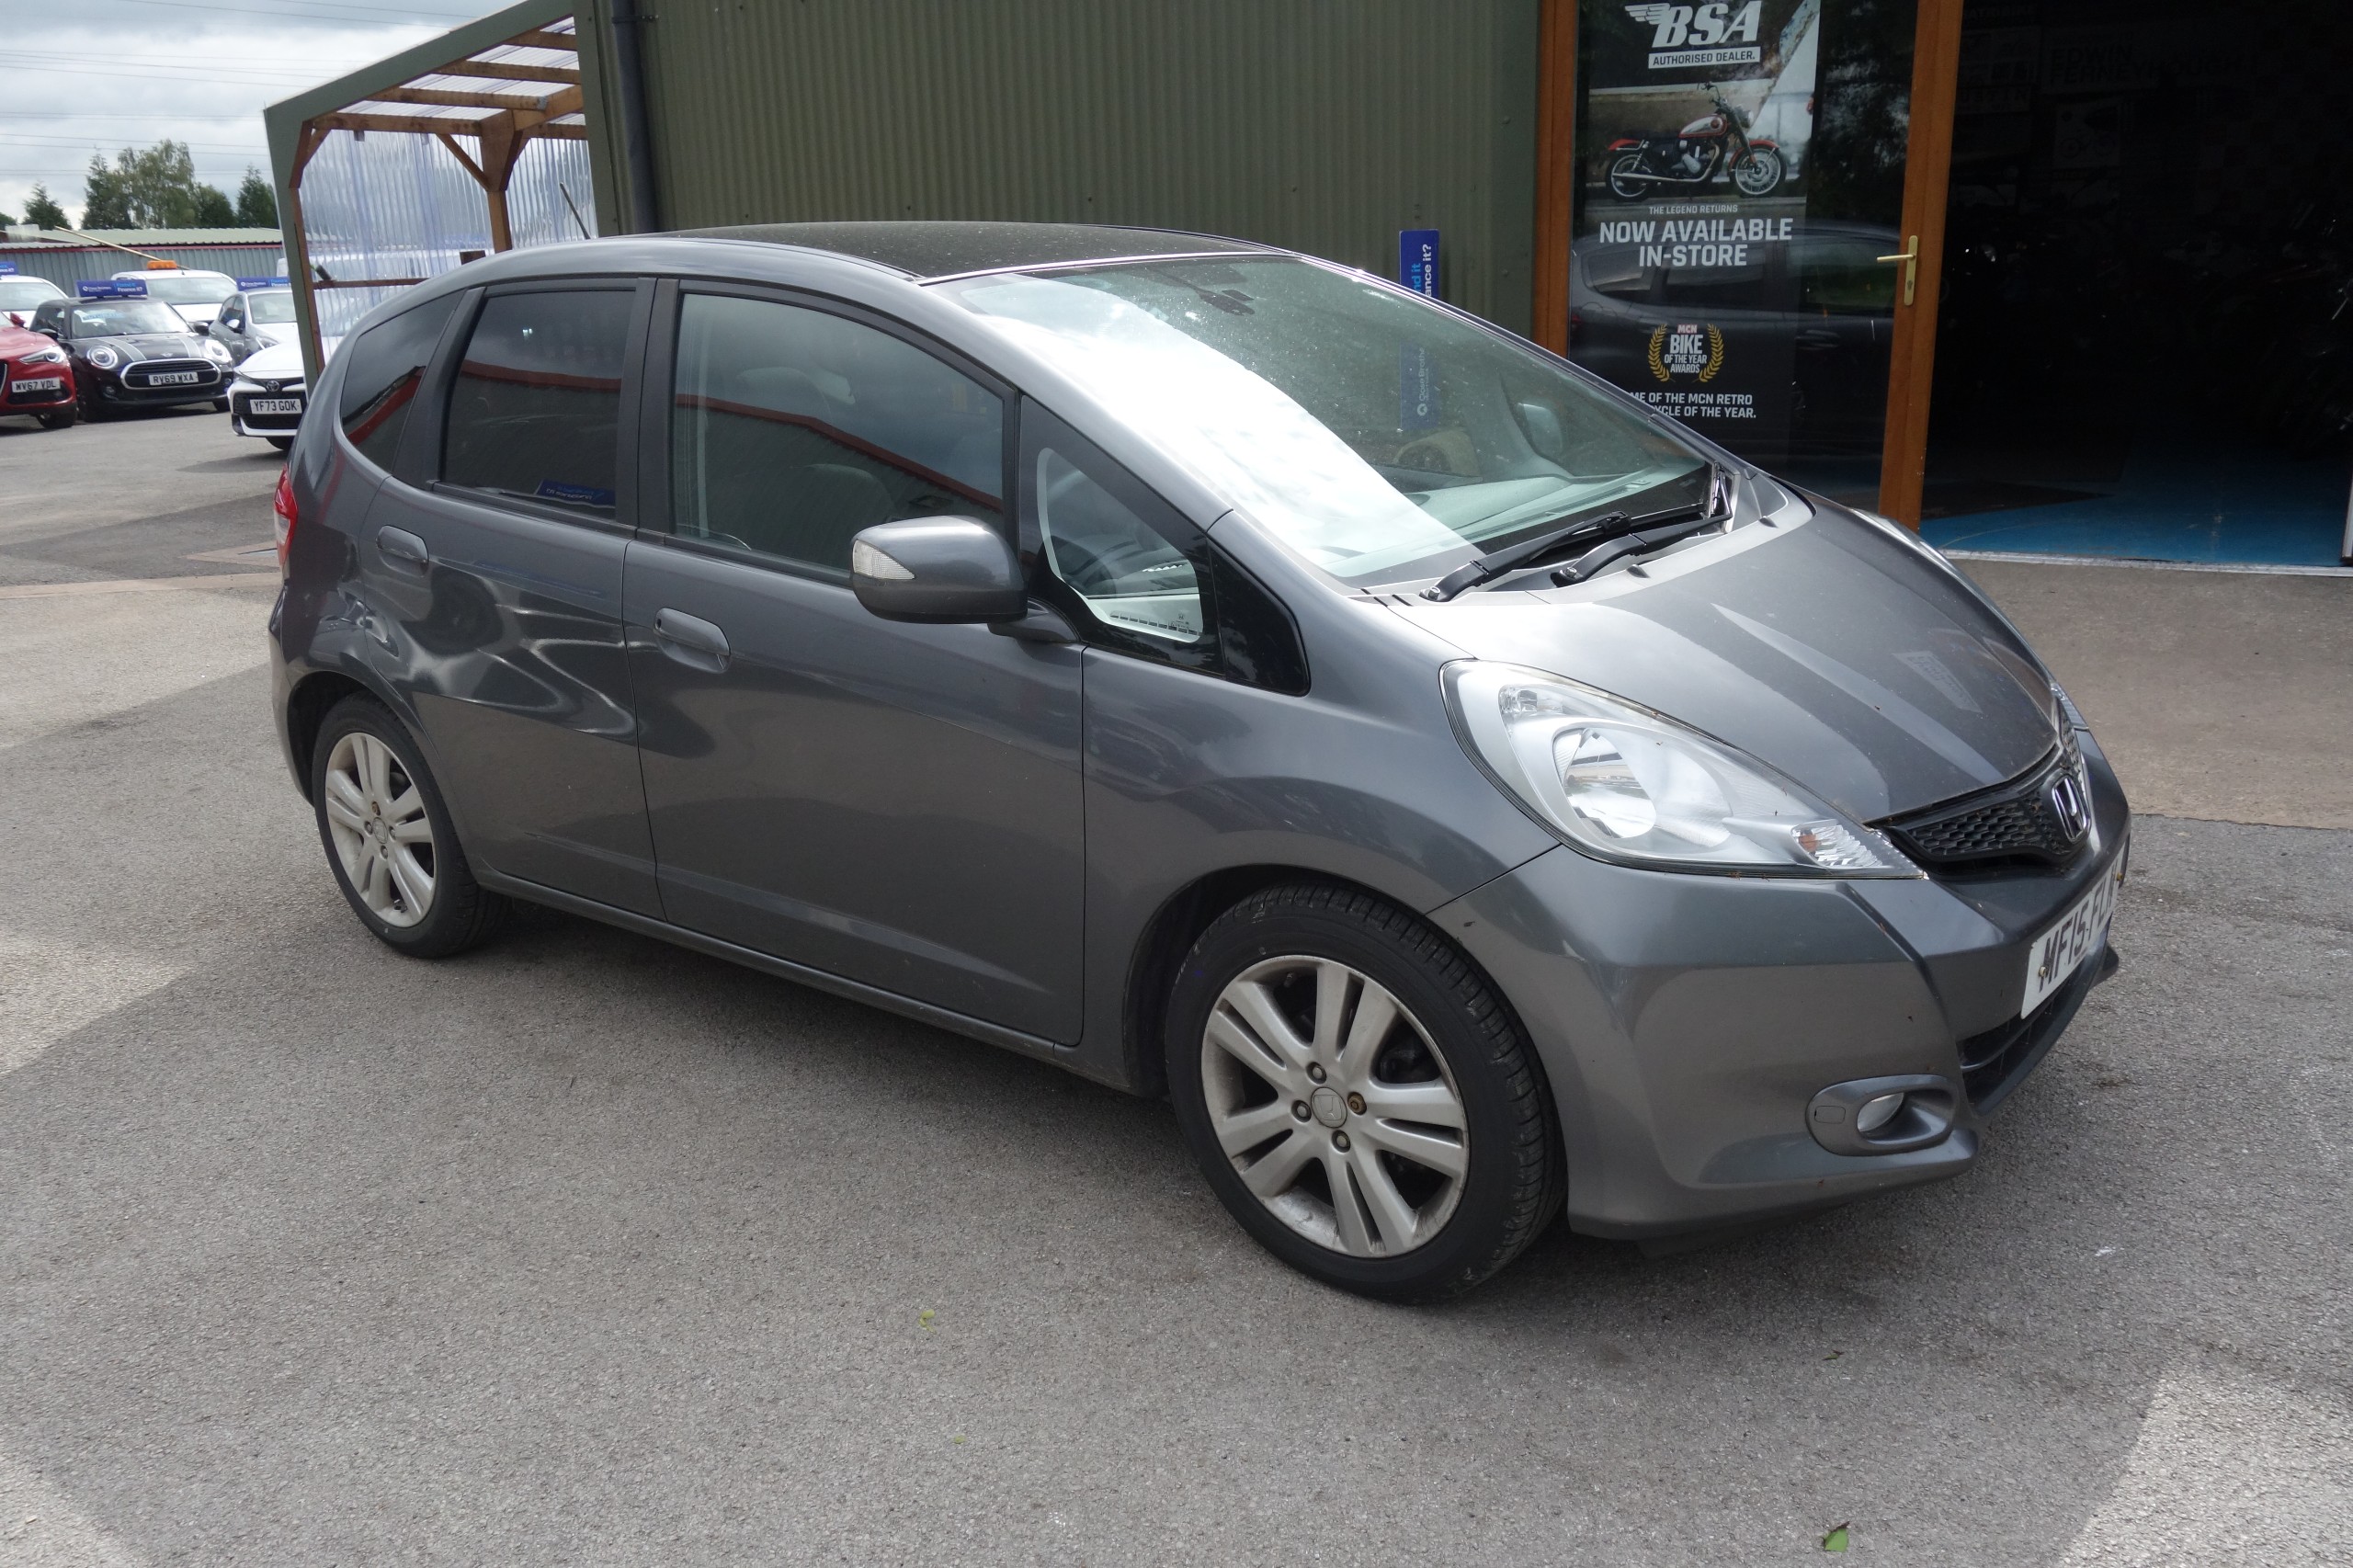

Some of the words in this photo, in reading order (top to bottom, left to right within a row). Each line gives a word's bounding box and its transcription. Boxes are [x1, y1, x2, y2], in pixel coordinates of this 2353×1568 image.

[1652, 1, 1762, 48] BSA
[1653, 53, 1712, 65] AUTHORISED
[1716, 51, 1756, 62] DEALER.
[1649, 206, 1665, 214] THE
[1666, 206, 1698, 214] LEGEND
[1699, 204, 1738, 213] RETURNS
[1599, 221, 1655, 244] NOW
[1661, 218, 1794, 243] AVAILABLE
[1422, 244, 1432, 262] it?
[1639, 244, 1748, 267] IN-STORE
[1411, 263, 1421, 273] it
[1411, 276, 1421, 292] nd
[1677, 324, 1698, 334] MCN
[1670, 334, 1703, 354] BIKE
[1664, 354, 1674, 363] OF
[1675, 354, 1688, 363] THE
[1688, 354, 1707, 364] YEAR
[1670, 363, 1700, 373] AWARDS
[153, 374, 176, 383] RV69
[1630, 392, 1645, 403] ME
[1648, 392, 1663, 403] OF
[1665, 392, 1685, 403] THE
[1688, 393, 1713, 404] MCN
[1716, 393, 1753, 405] RETRO
[254, 401, 277, 412] YF73
[278, 401, 298, 411] GOK
[1654, 405, 1681, 416] YCLE
[1684, 406, 1699, 416] OF
[1700, 406, 1722, 417] THE
[1723, 407, 1756, 419] YEAR.
[2039, 900, 2089, 994] MF15
